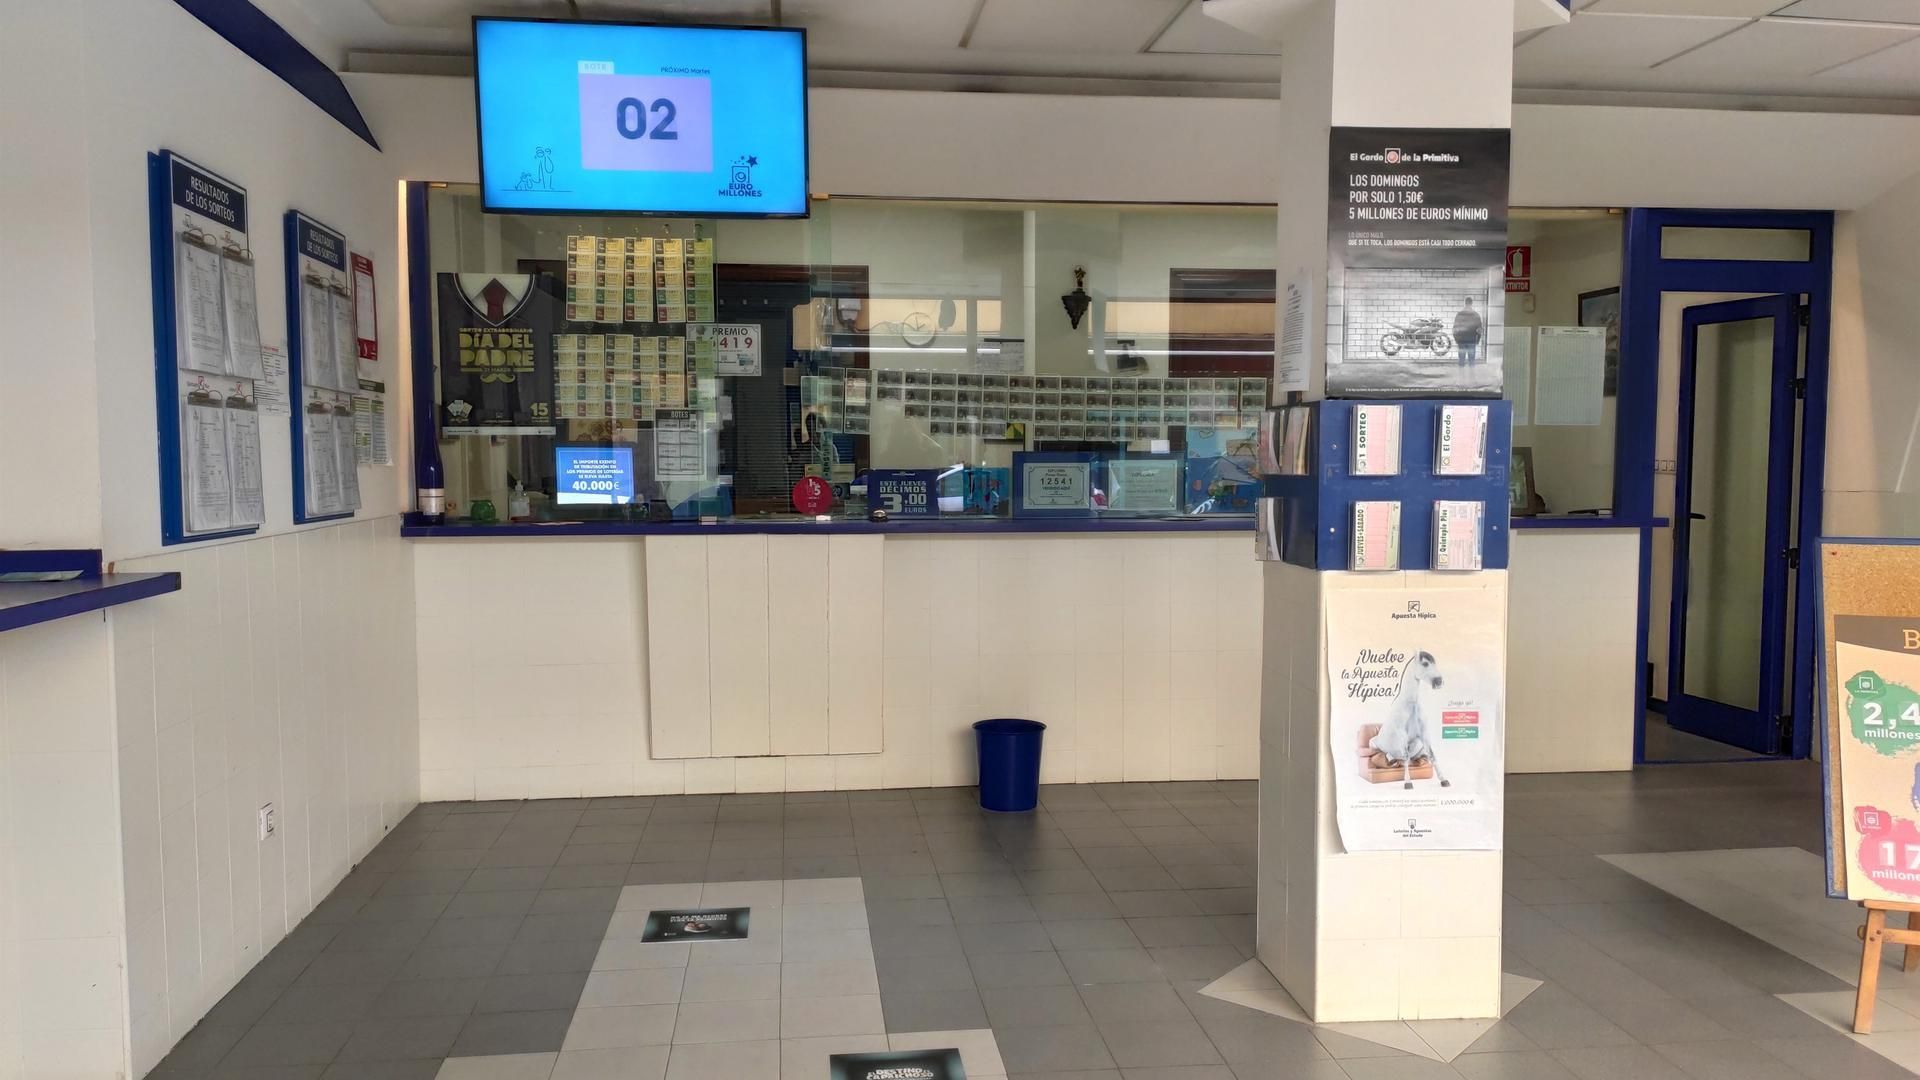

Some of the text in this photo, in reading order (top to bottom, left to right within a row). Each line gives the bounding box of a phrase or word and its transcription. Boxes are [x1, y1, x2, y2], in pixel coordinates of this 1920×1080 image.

[616, 96, 679, 140] 02
[1350, 153, 1460, 162] El Gordo de la Primitiva
[1350, 175, 1420, 187] LOS DOMINGOS
[190, 175, 230, 205] RESULTADOS
[1349, 191, 1424, 205] POR SOLO 1,50€
[185, 190, 235, 223] DE LOS SORTEOS
[1349, 205, 1489, 221] 5 MILLONES DE EUROS MÍNIMO
[309, 228, 335, 250] RESULTADOS
[712, 327, 749, 336] PREMIO
[498, 333, 534, 348] DEL
[460, 349, 535, 367] PADRE
[529, 402, 549, 416] 15
[1359, 412, 1367, 449] SORTEO
[1443, 413, 1452, 452] El Gordo
[1341, 665, 1399, 683] la Apuesta
[1865, 729, 1920, 740] millones
[875, 1067, 923, 1075] DESTINO
